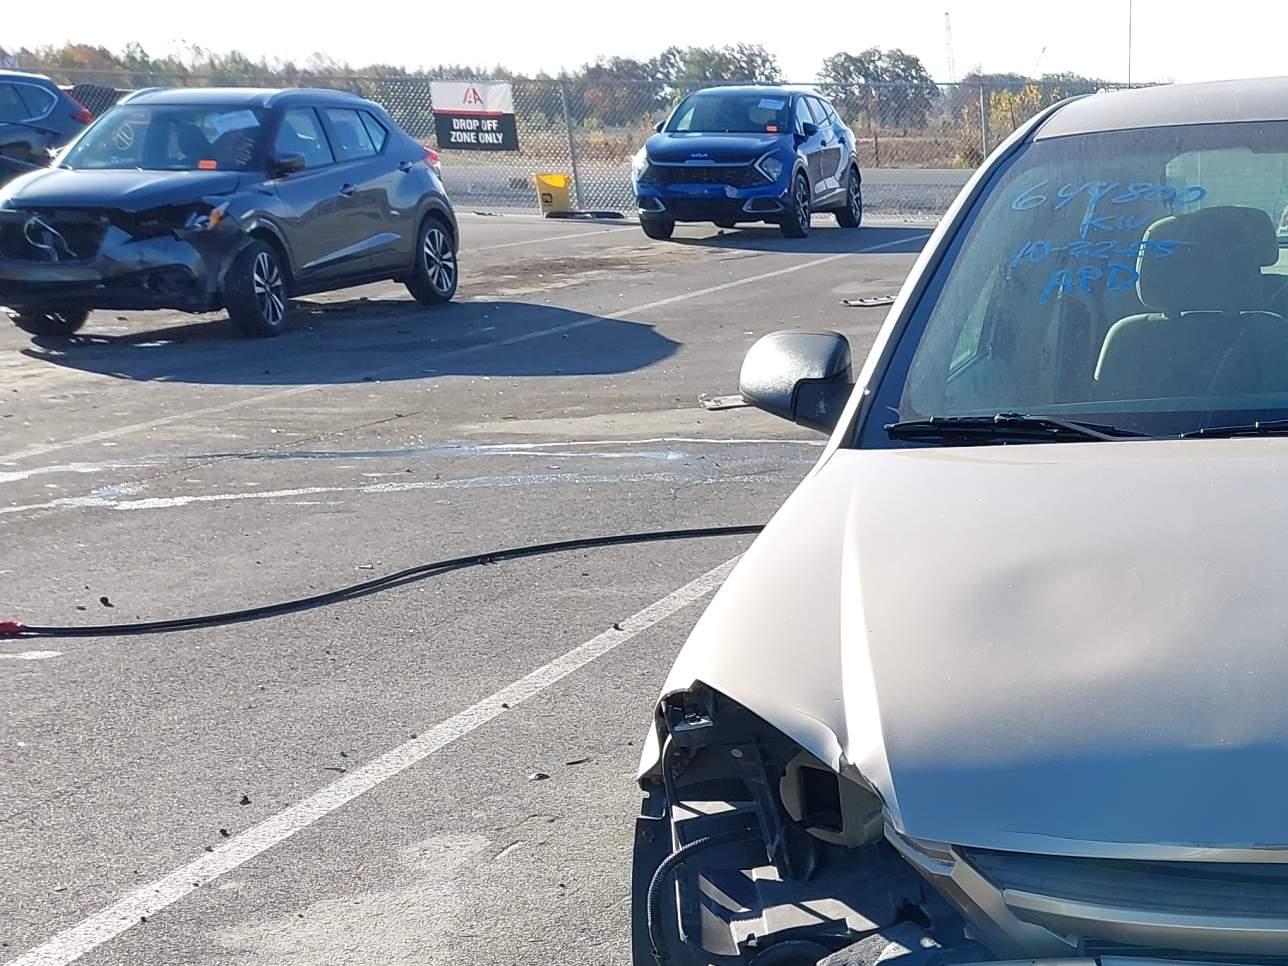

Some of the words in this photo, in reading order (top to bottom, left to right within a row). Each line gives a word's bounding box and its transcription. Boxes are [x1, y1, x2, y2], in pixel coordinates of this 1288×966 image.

[452, 118, 480, 130] DROP
[481, 119, 498, 130] OFF
[450, 131, 477, 143] ZONE
[478, 132, 503, 144] ONLY
